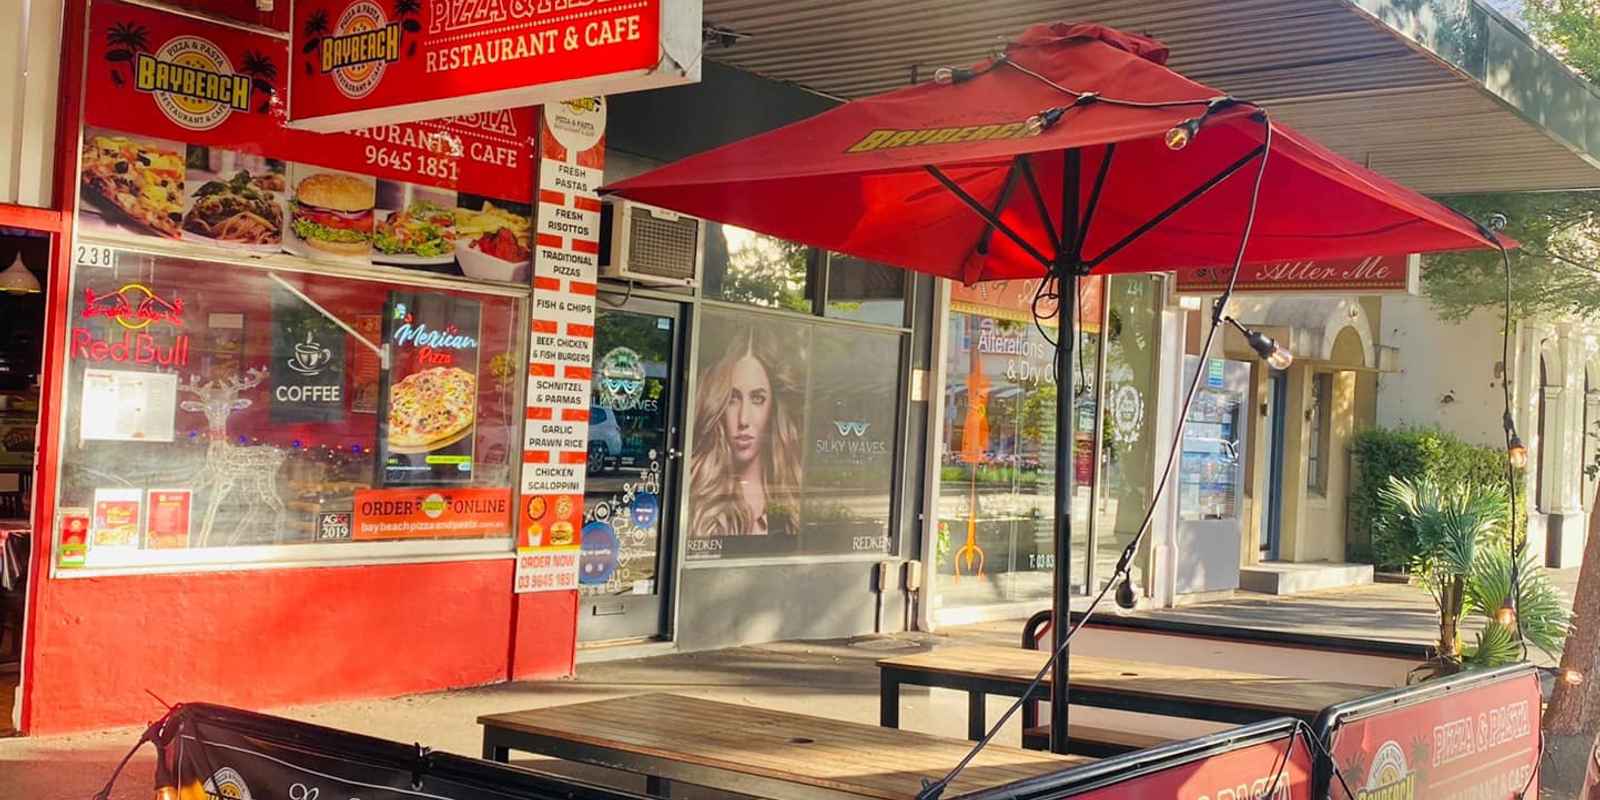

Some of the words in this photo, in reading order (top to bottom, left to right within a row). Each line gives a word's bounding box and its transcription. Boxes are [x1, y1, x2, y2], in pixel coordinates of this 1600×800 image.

[322, 25, 398, 72] BAYBEACH
[426, 31, 558, 73] RESTAURANT
[563, 27, 579, 51] &
[585, 15, 640, 48] CAFE
[199, 43, 224, 67] PASTA
[138, 56, 249, 110] BAYBEACH
[365, 145, 412, 172] 9645
[416, 154, 459, 181] 1851
[470, 142, 517, 169] CAFE
[558, 165, 586, 177] FRESH
[555, 178, 587, 192] PASTAS
[555, 208, 584, 221] FRESH
[548, 221, 589, 235] RISOTTOS
[78, 246, 111, 265] 238
[542, 250, 592, 265] TRADITIONAL
[553, 265, 580, 277] PIZZAS
[1256, 258, 1336, 281] Alter
[1343, 256, 1392, 280] Me
[537, 299, 556, 310] FISH
[559, 301, 564, 310] &
[567, 303, 592, 314] CHIPS
[394, 323, 478, 348] Mexican
[71, 328, 128, 362] Red
[136, 333, 189, 367] Bull
[557, 338, 588, 349] CHICKEN
[977, 334, 1045, 358] Alterations
[420, 347, 456, 366] Pizza
[540, 351, 556, 360] FISH
[558, 352, 590, 362] BURGERS
[1007, 360, 1016, 380] &
[1020, 361, 1040, 387] Dry
[276, 386, 340, 401] COFFEE
[536, 381, 583, 392] SCHNITZEL
[536, 394, 542, 402] &
[545, 395, 581, 404] PARMAS
[542, 425, 573, 434] GARLIC
[529, 438, 562, 447] PRAWN
[564, 439, 583, 448] RICE
[816, 440, 846, 454] SILKY
[849, 441, 886, 455] WAVES
[536, 468, 573, 477] CHICKEN
[528, 481, 579, 490] SCALOPPINI
[362, 501, 413, 516] ORDER
[454, 499, 505, 514] ONLINE
[322, 527, 348, 538] 2019
[687, 539, 722, 551] REDKEN
[853, 536, 892, 551] REDKEN
